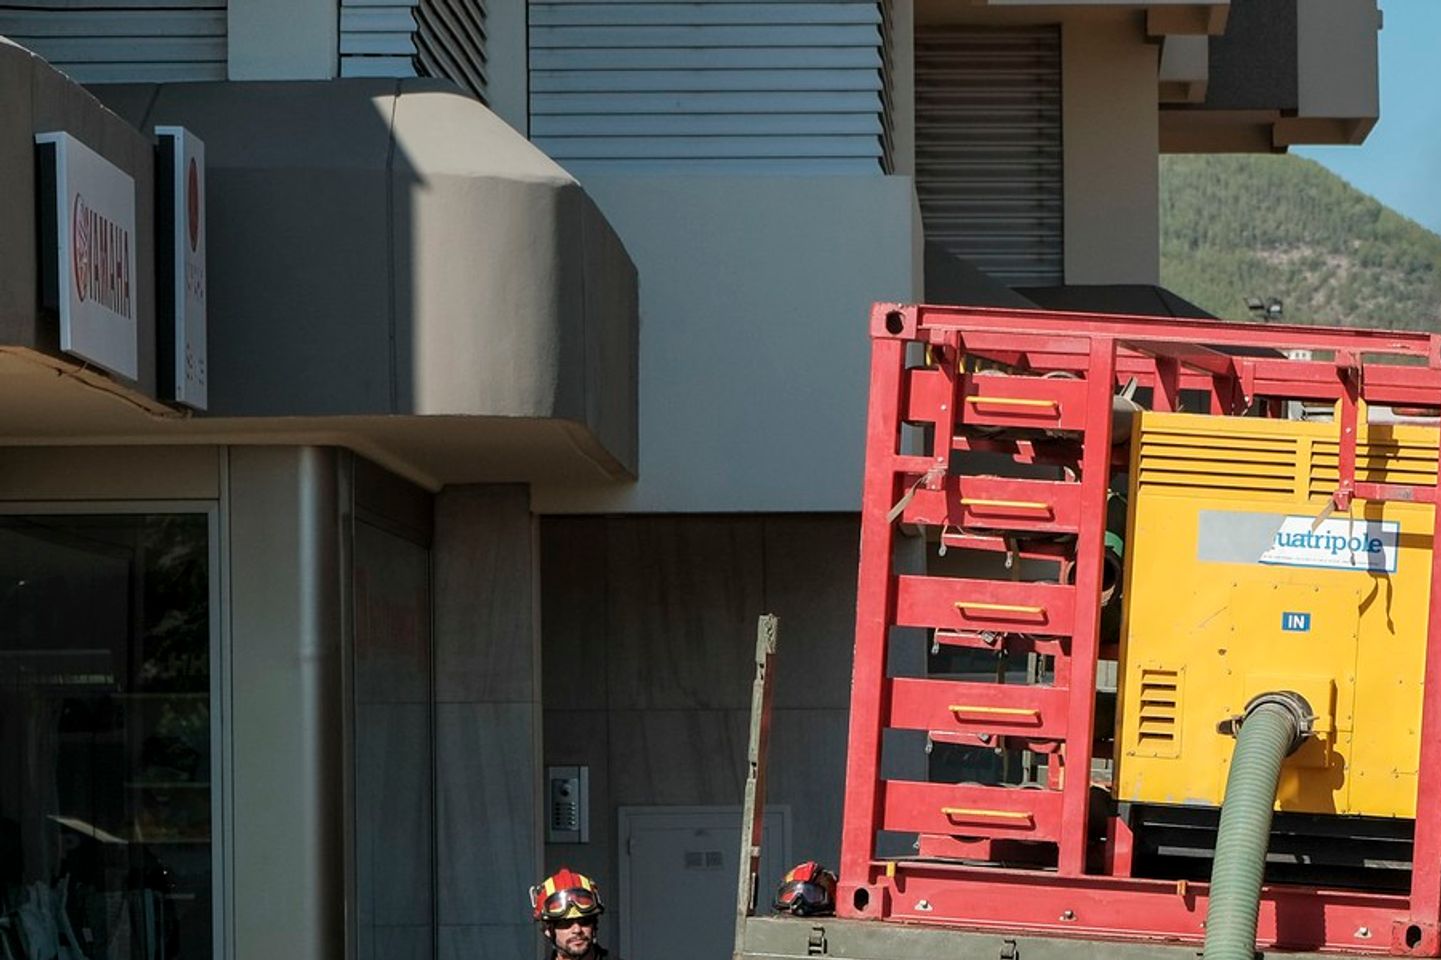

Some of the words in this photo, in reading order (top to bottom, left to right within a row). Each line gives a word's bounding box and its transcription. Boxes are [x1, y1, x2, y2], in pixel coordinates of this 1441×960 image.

[85, 206, 131, 320] YAMAHA
[1274, 529, 1383, 555] uatripole
[1288, 615, 1305, 628] IN
